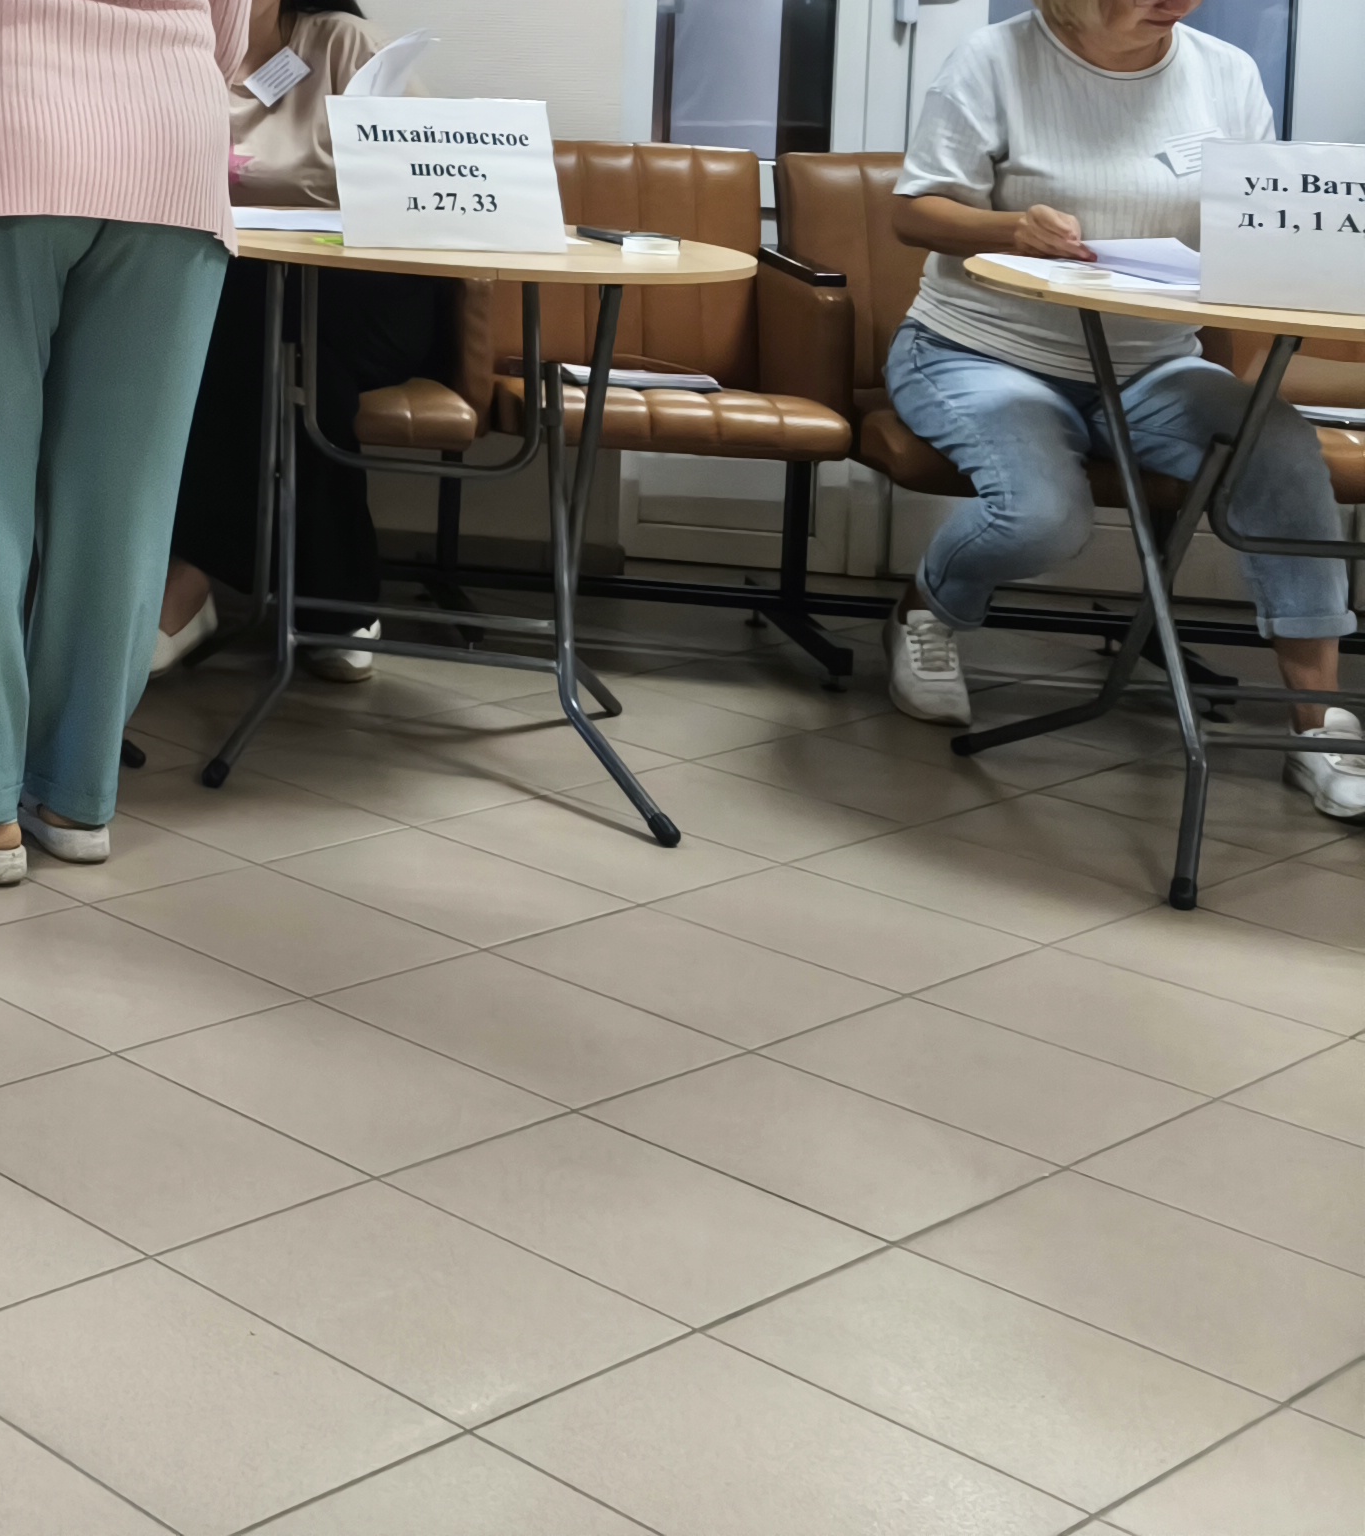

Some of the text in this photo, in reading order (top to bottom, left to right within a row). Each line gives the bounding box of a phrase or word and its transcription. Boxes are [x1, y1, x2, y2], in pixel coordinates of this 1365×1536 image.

[356, 123, 530, 147] Михайловское
[410, 161, 487, 181] шоссе,
[1243, 176, 1289, 196] ул.
[406, 192, 499, 216] д. 27, 33
[1237, 212, 1264, 230] д.
[1276, 209, 1301, 234] 1,
[1312, 211, 1324, 231] 1
